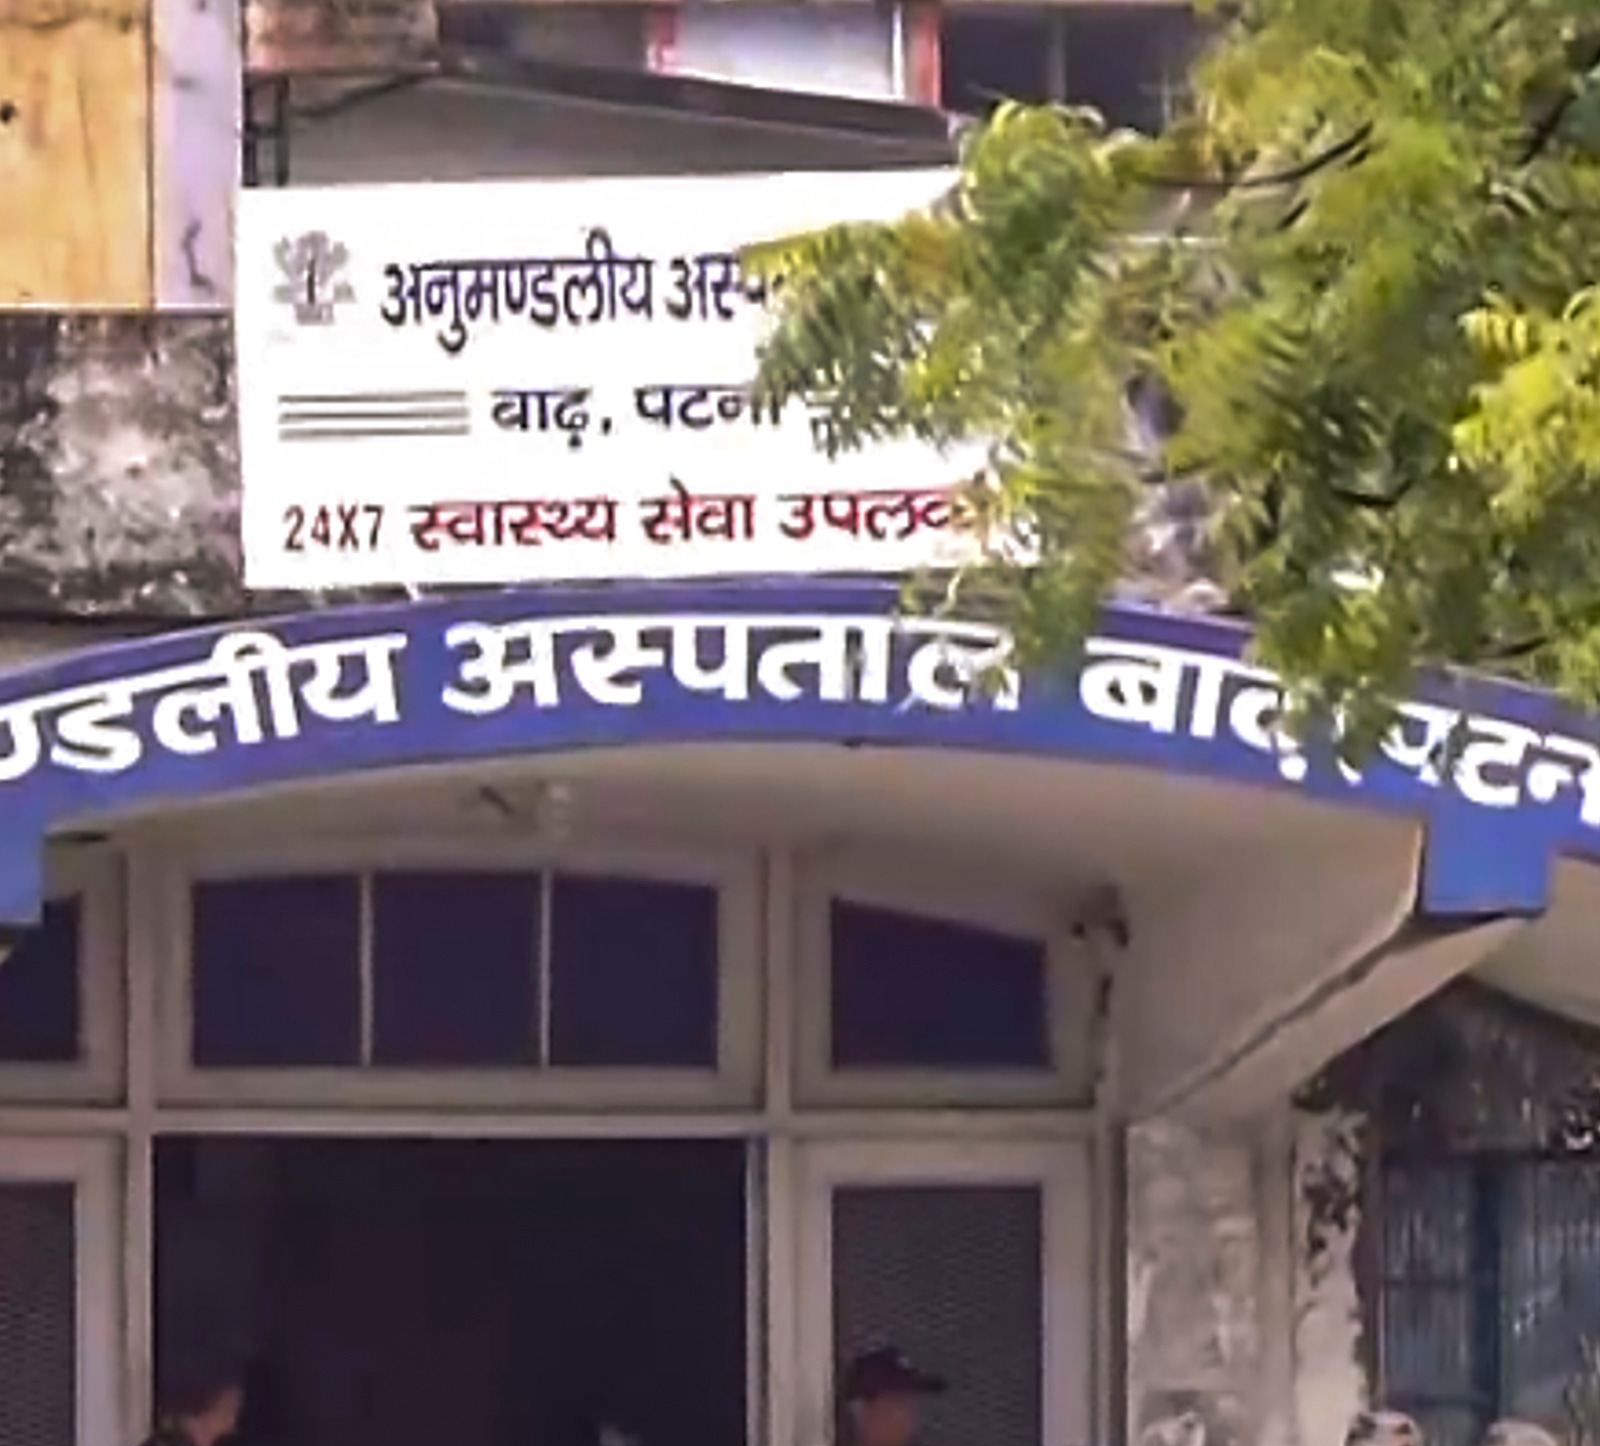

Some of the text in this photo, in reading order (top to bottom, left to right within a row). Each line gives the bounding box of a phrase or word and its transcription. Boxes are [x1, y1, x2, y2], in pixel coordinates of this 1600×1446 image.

[283, 503, 384, 553] 24X7
[408, 498, 620, 553] स्वास्थ्य
[640, 476, 756, 544] सेवा
[441, 612, 1020, 719] अस्पताल
